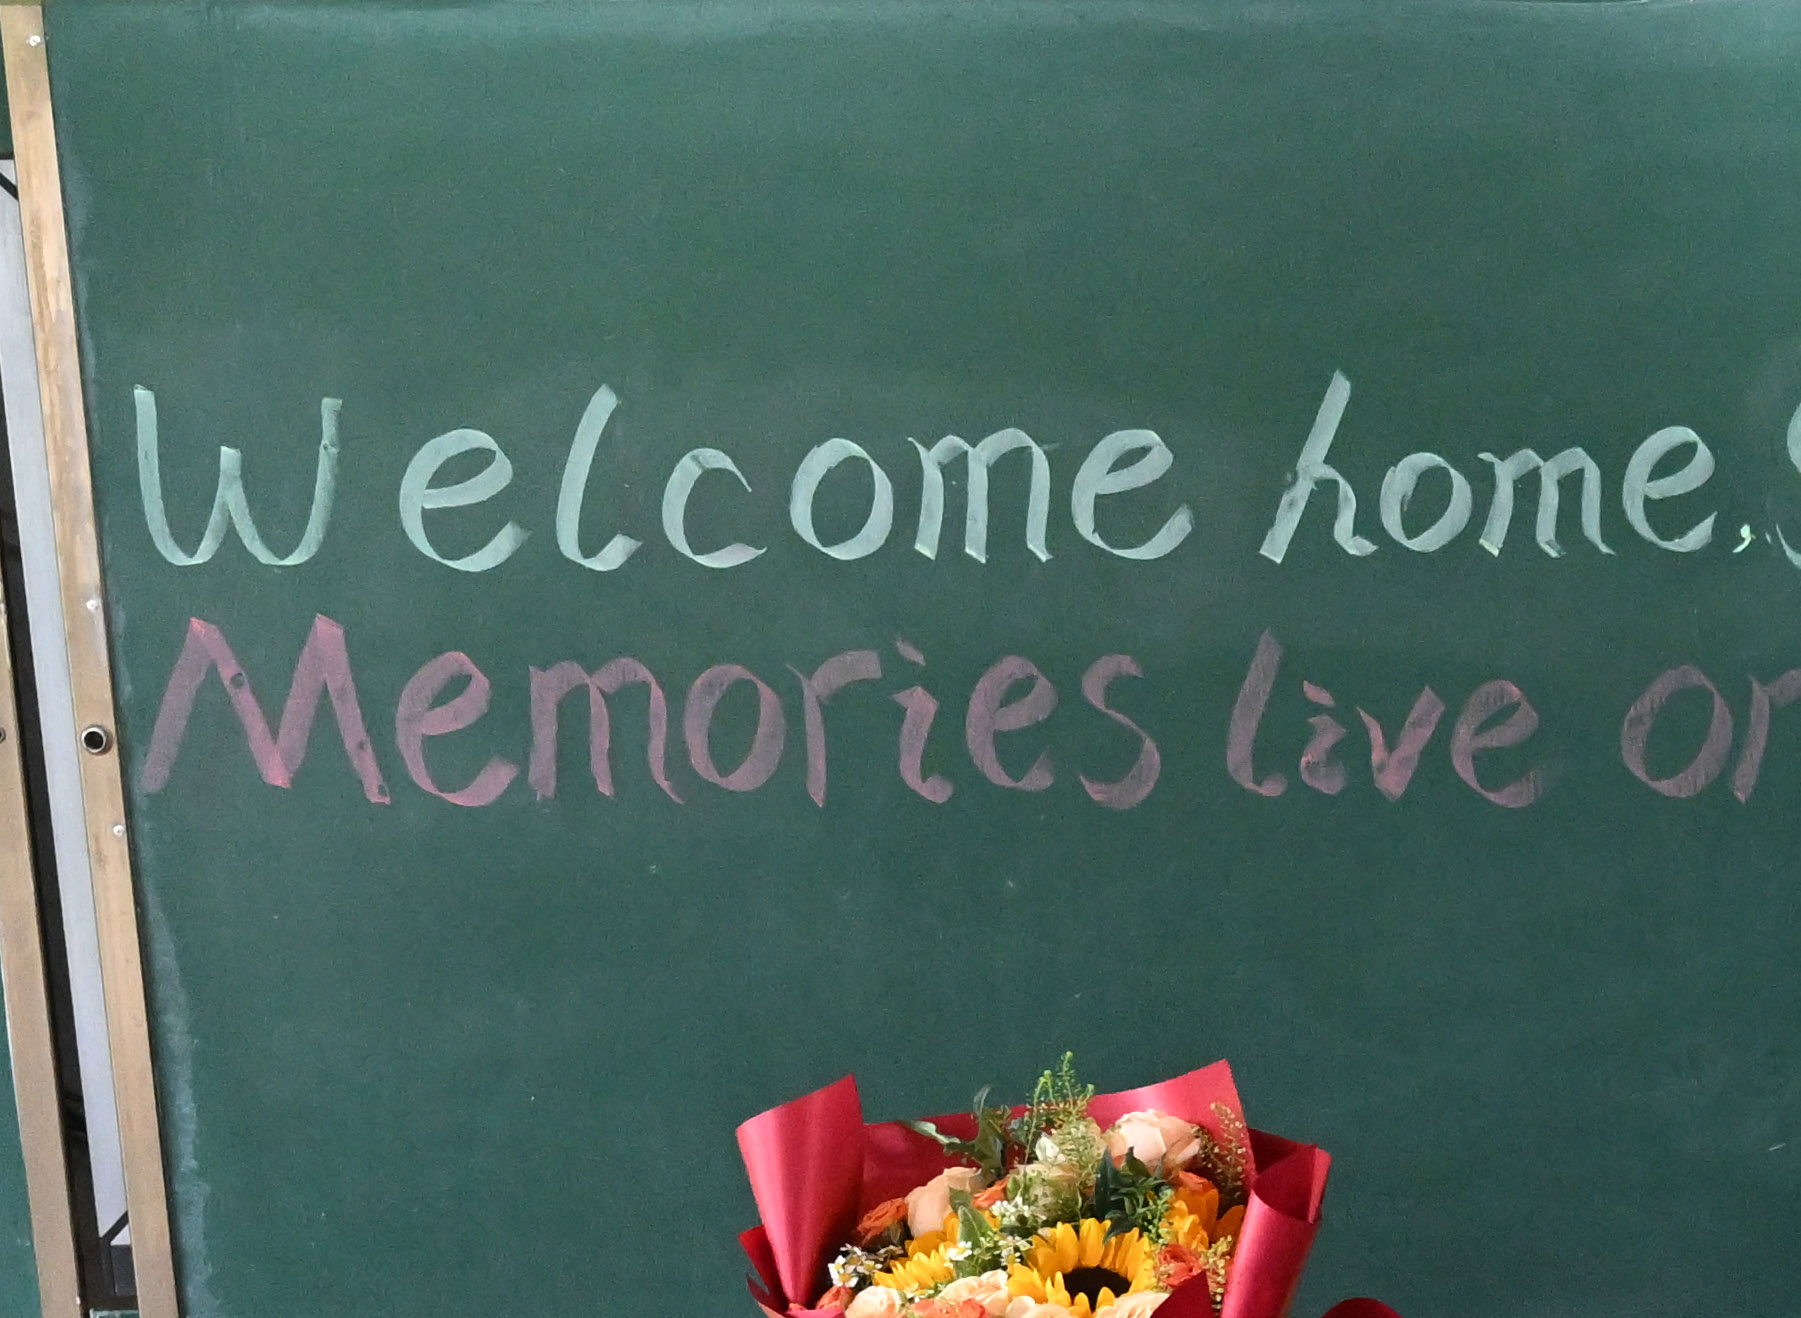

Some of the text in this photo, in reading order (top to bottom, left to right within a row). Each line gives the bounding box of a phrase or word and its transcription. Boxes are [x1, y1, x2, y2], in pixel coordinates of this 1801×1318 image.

[132, 383, 1195, 573] Welcome
[138, 612, 1162, 809] Memories
[1226, 627, 1556, 809] live
